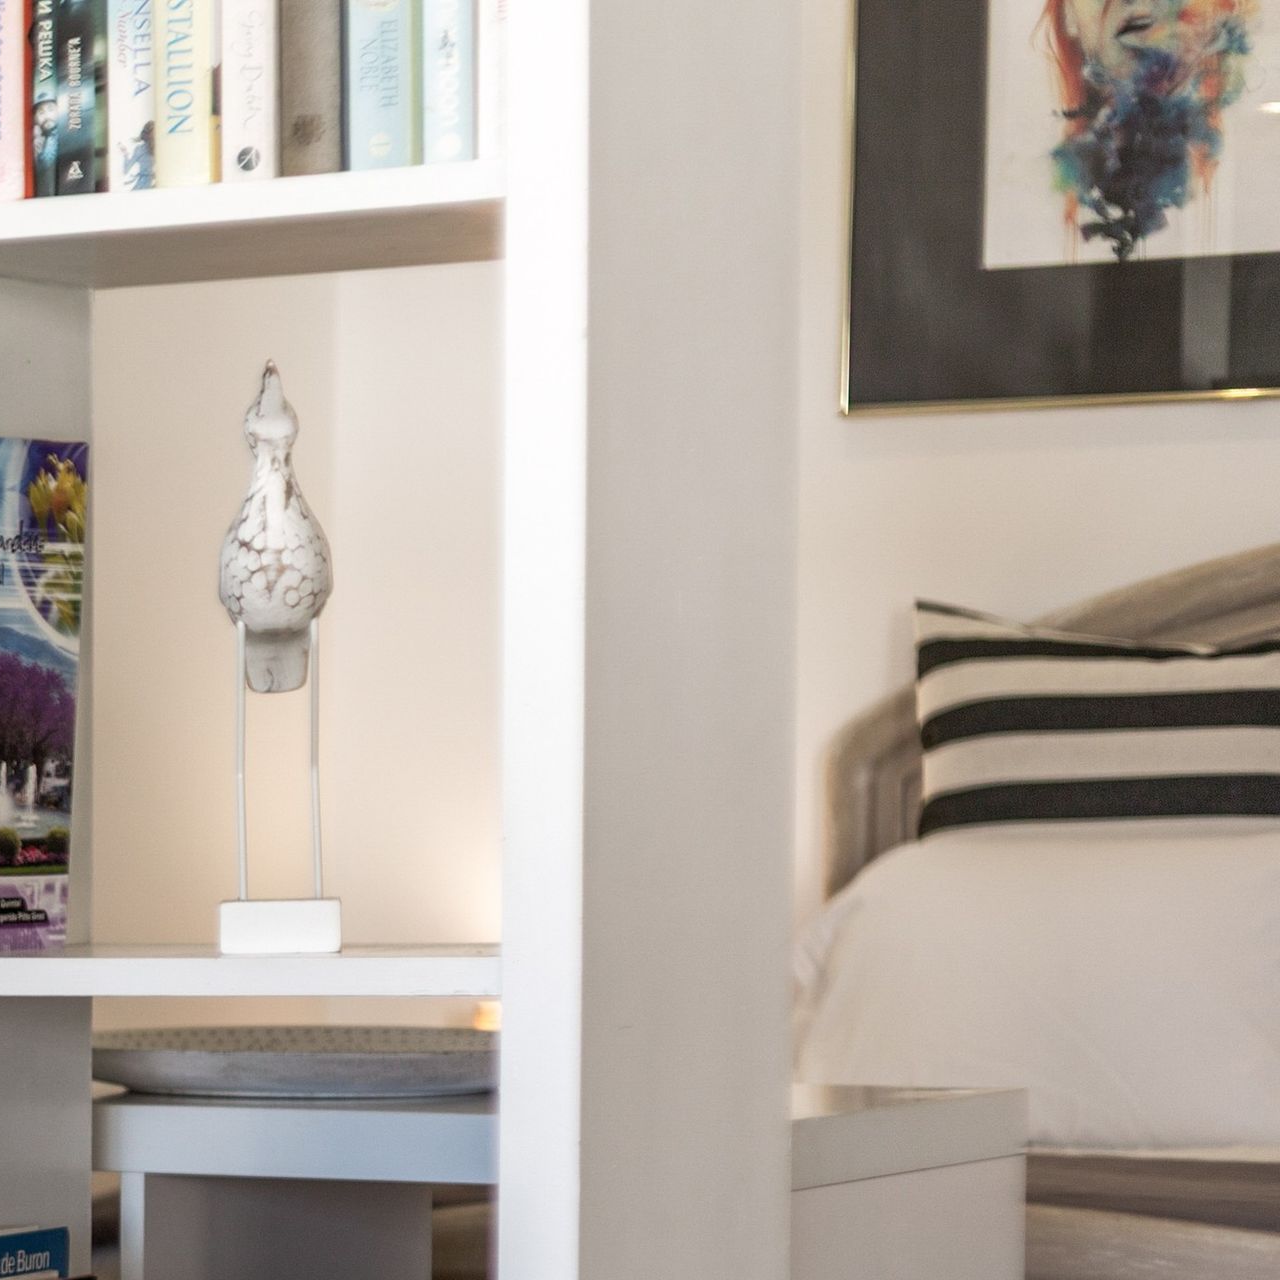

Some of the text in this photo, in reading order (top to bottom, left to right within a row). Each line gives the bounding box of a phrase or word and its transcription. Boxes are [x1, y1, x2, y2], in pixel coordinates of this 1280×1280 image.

[38, 20, 54, 83] РЕШКА
[117, 9, 134, 69] Number
[166, 0, 195, 136] STALLION
[359, 37, 381, 94] NOBLE
[378, 18, 401, 109] ELIZABETH
[0, 1254, 15, 1274] de
[16, 1250, 50, 1272] Buron
